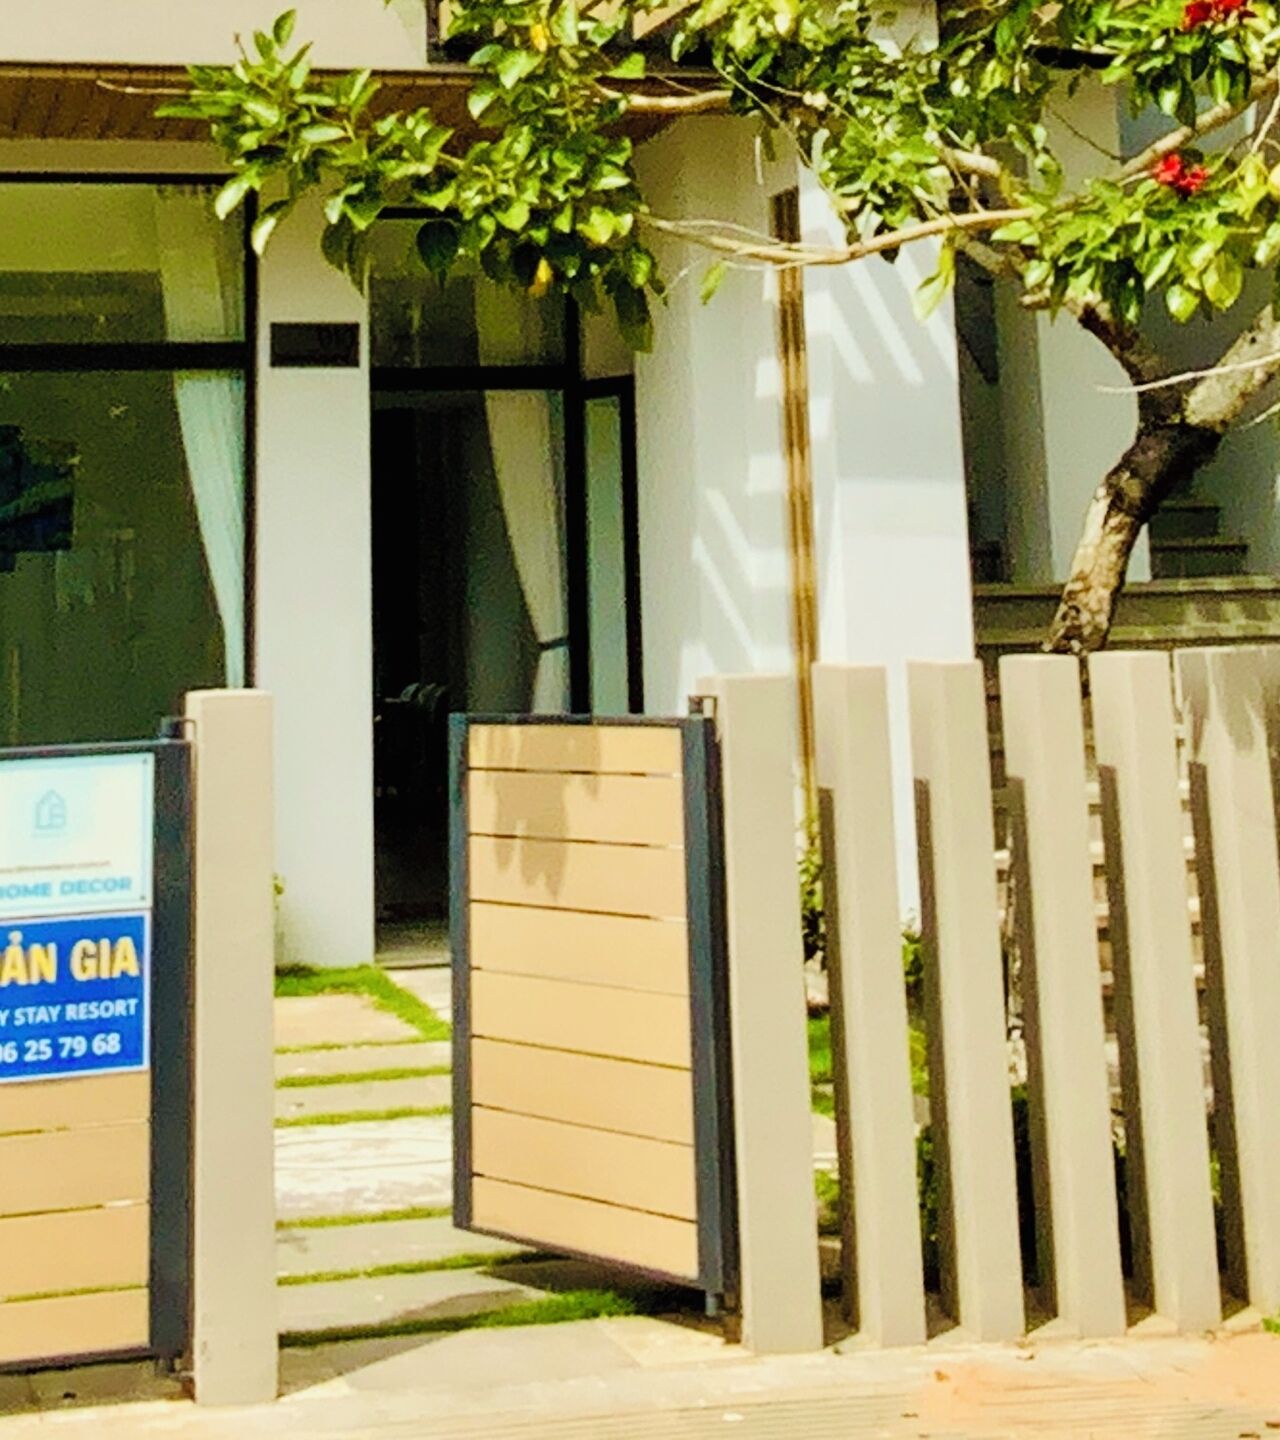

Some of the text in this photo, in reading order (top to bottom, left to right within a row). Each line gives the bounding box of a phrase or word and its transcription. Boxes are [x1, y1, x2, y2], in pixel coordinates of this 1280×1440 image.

[59, 876, 132, 896] DECOR
[70, 936, 140, 981] GIA
[14, 1006, 62, 1027] STAY
[65, 999, 138, 1021] RESORT
[24, 1037, 53, 1061] 25
[59, 1035, 87, 1058] 79
[92, 1032, 121, 1055] 68
